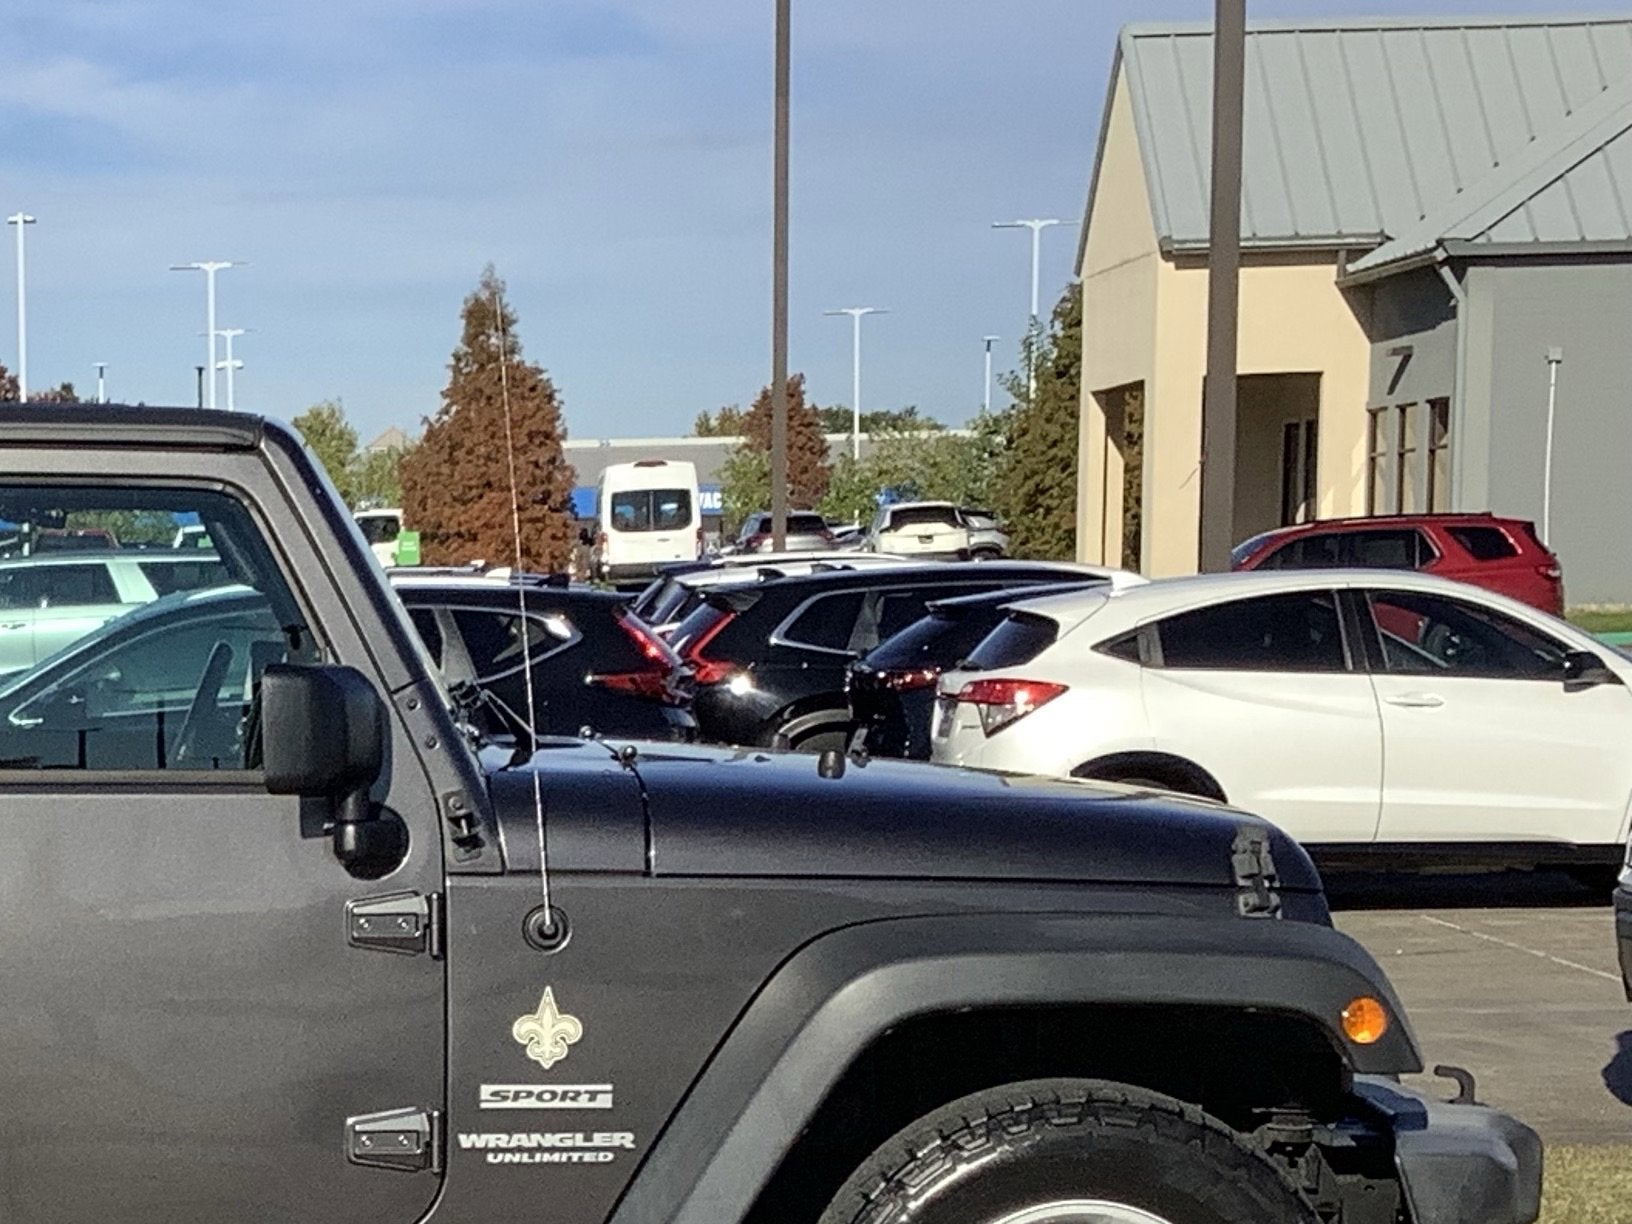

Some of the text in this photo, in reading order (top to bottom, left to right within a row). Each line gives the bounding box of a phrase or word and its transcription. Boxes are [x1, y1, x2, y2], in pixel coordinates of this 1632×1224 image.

[488, 1089, 604, 1103] SPORT
[457, 1131, 636, 1149] WRANGLER
[486, 1151, 615, 1164] UNLIMITED
